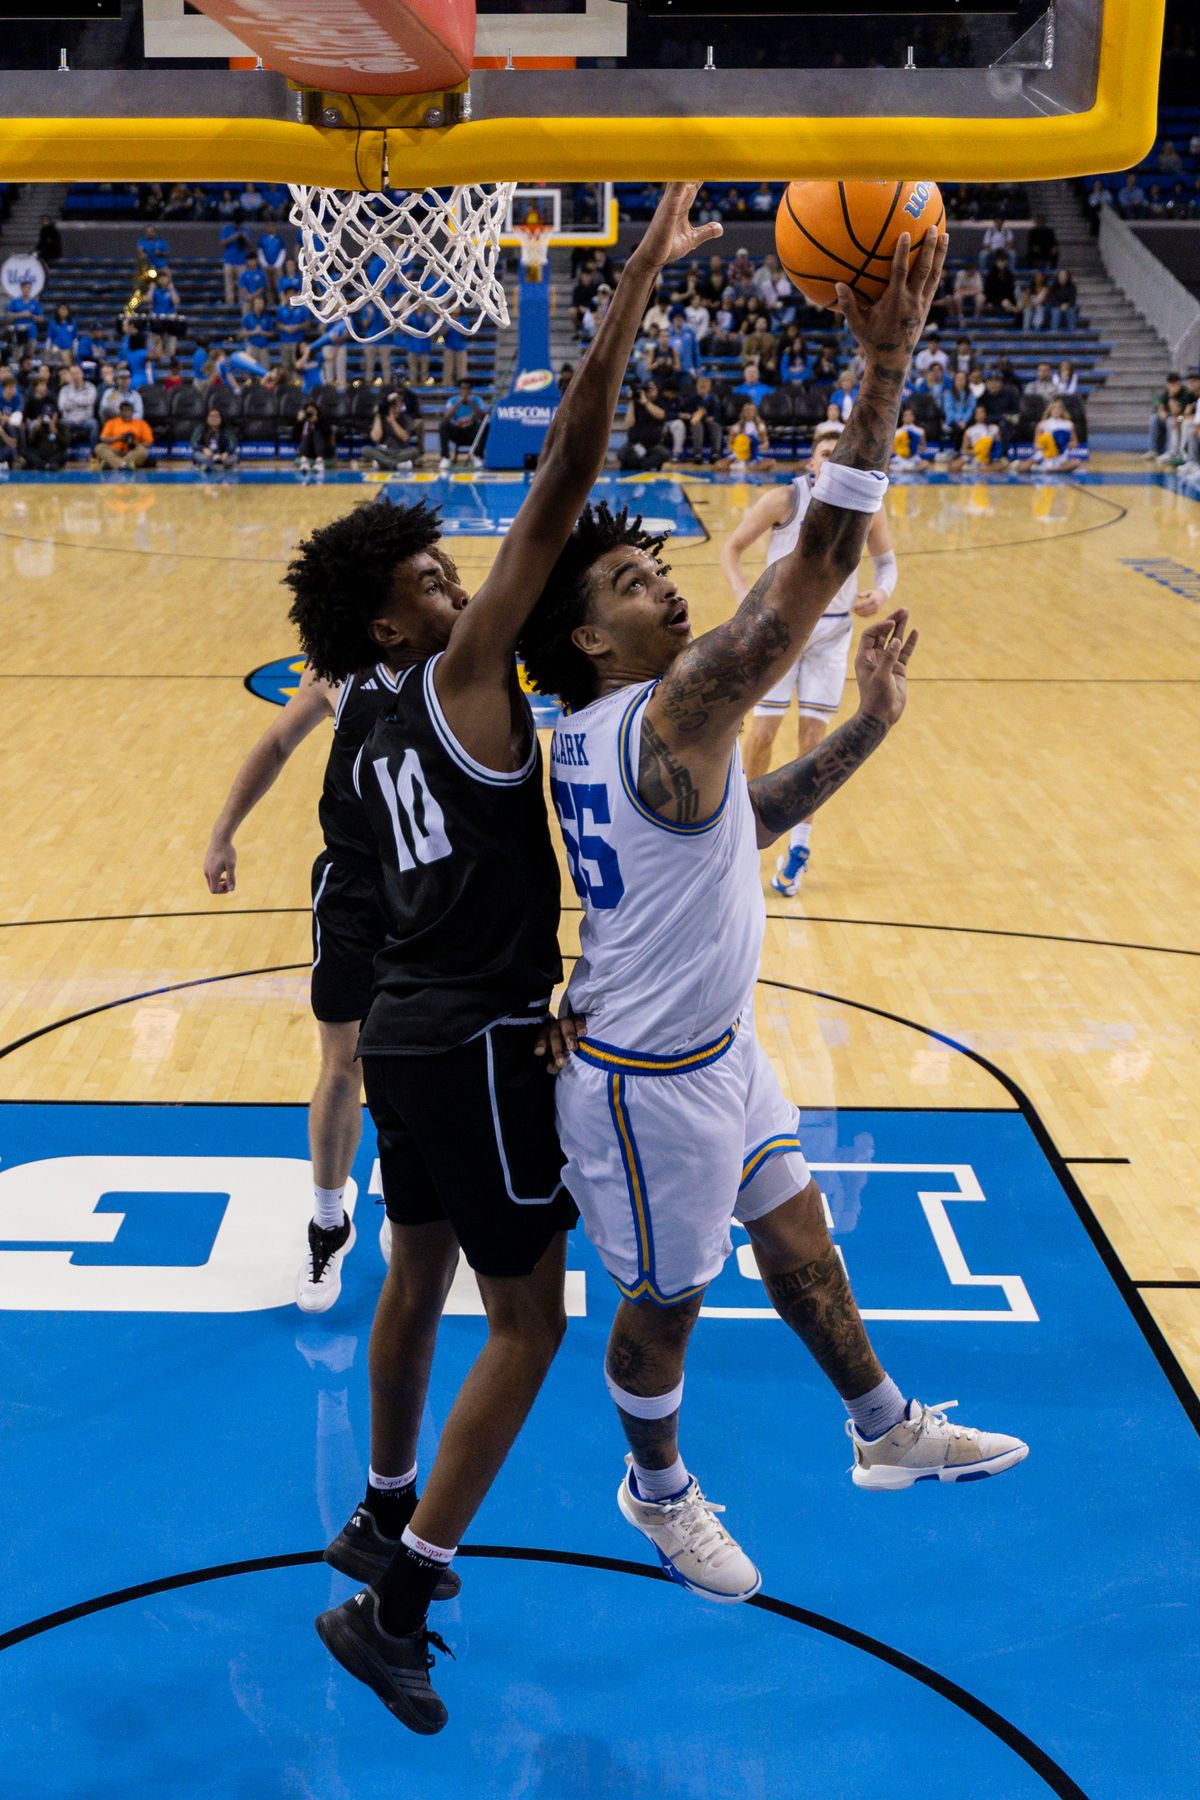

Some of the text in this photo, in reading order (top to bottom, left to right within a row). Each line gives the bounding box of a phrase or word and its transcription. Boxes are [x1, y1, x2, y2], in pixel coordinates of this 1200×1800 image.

[497, 406, 550, 419] WESCOM
[373, 749, 452, 872] 10
[550, 777, 625, 910] 55
[769, 1262, 822, 1297] WALK
